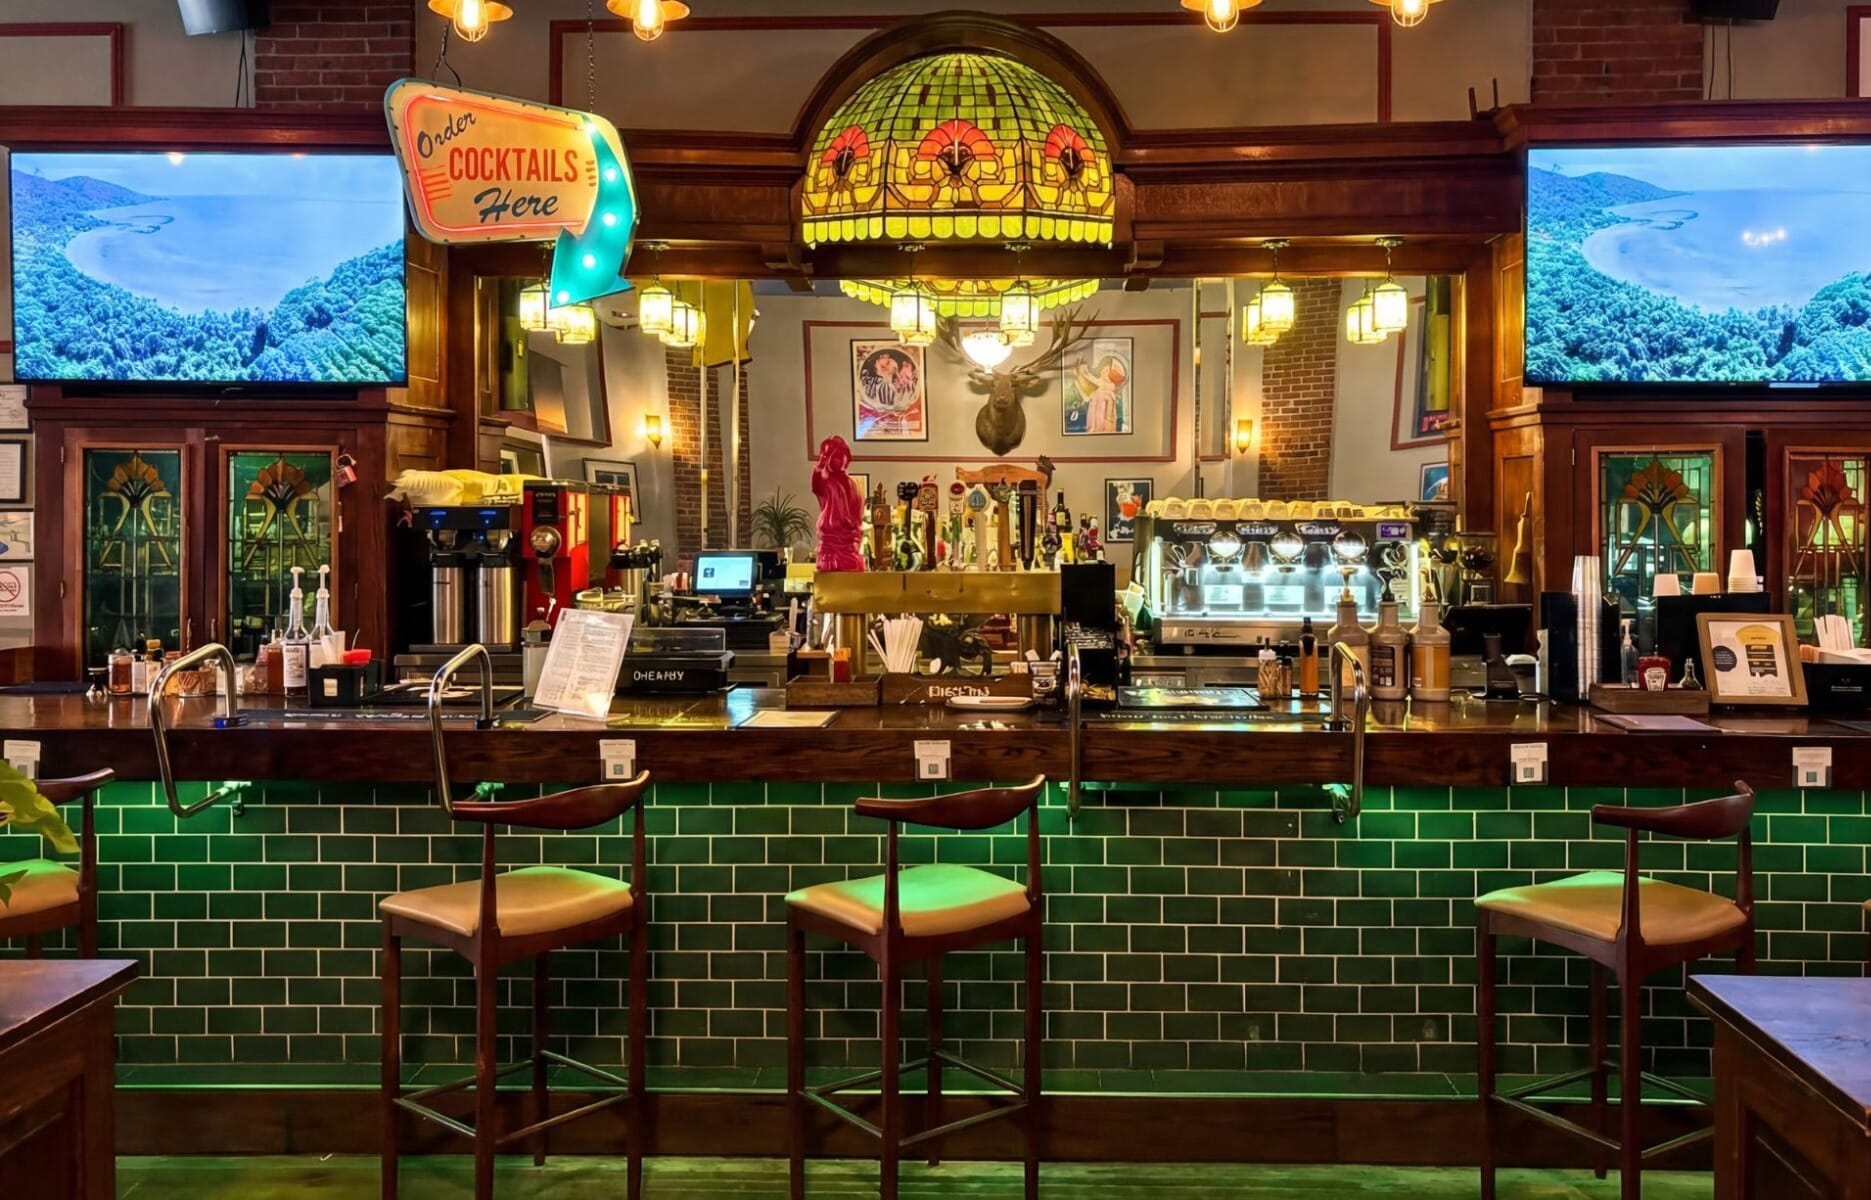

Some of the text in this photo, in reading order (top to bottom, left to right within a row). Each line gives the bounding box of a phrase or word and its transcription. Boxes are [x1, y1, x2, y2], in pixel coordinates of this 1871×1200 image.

[417, 112, 476, 159] Order
[449, 147, 578, 183] COCKTAILS
[474, 187, 559, 224] Here
